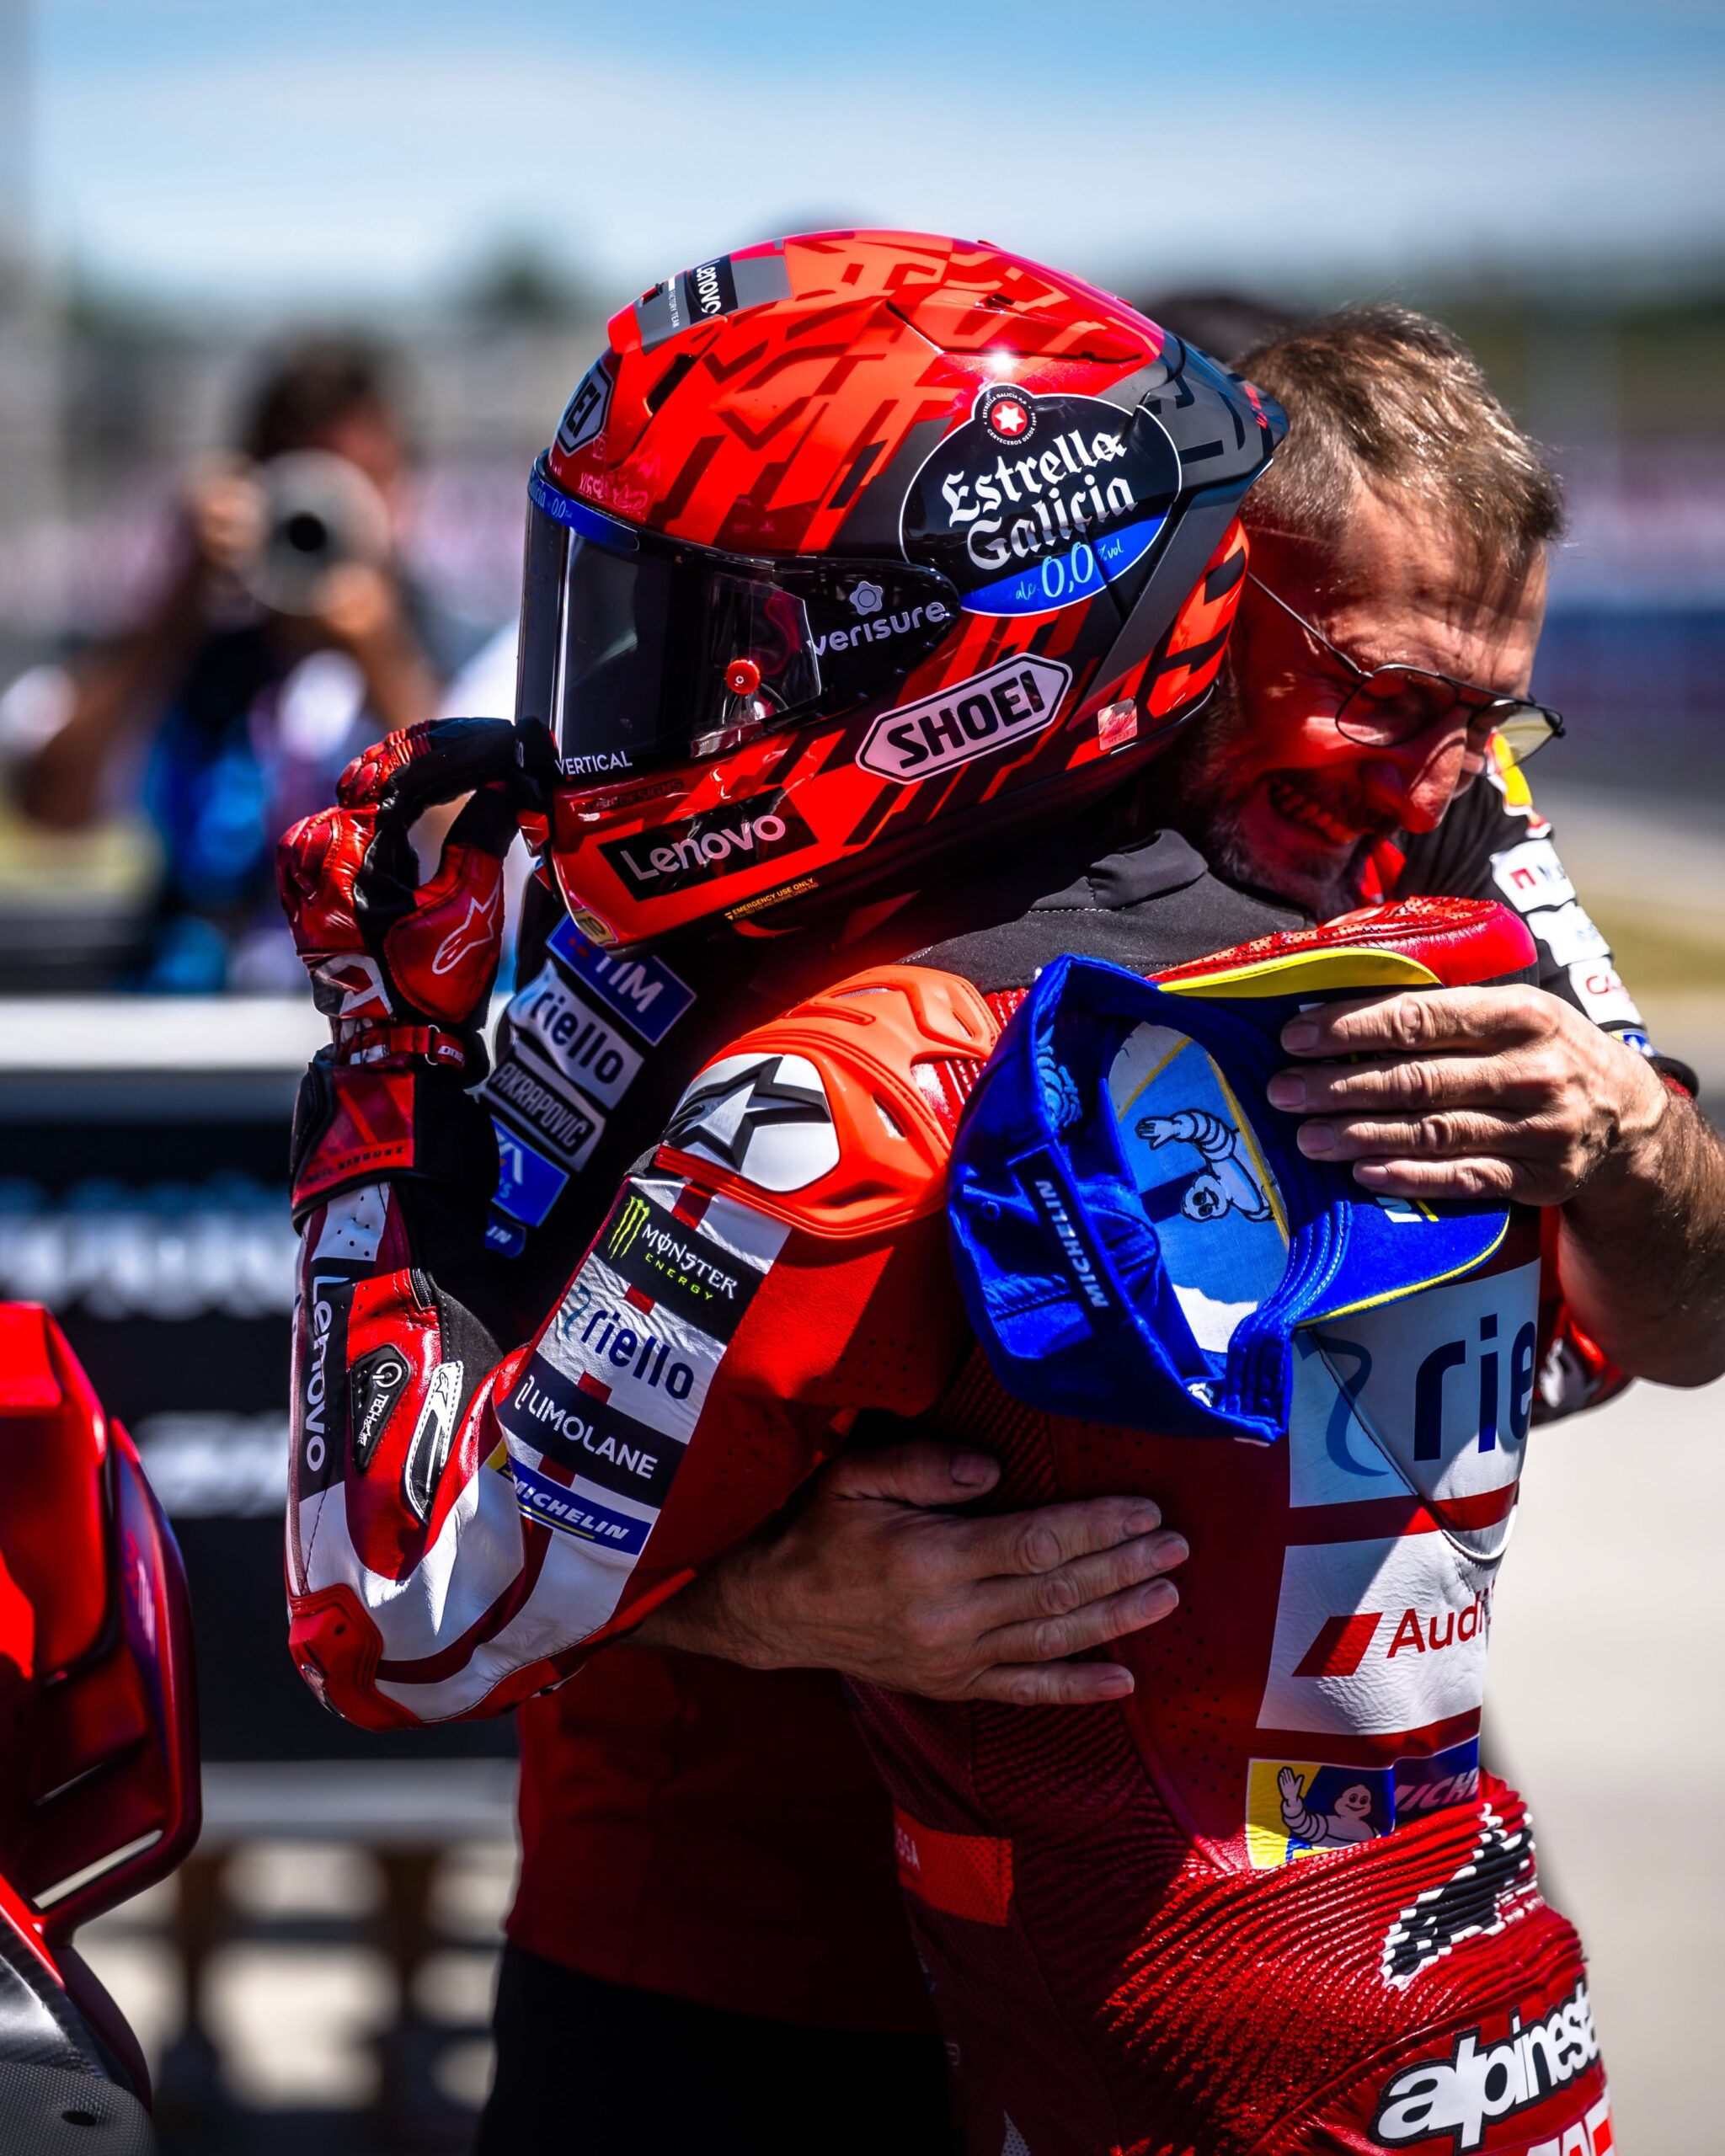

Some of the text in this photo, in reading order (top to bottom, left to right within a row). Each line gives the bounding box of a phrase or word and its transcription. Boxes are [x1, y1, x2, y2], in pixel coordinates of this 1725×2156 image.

[697, 259, 721, 314] Lenovo
[982, 397, 997, 419] ESTRELLA
[987, 428, 1022, 446] CERVECEROS
[1022, 427, 1035, 442] DESDE
[941, 429, 1128, 528] Estrella
[968, 473, 1138, 570] Galicia
[1041, 541, 1094, 598] 0,0
[806, 601, 947, 657] verisure
[886, 670, 1046, 770] SHOEI
[554, 750, 633, 776] VERTICAL
[620, 814, 787, 881] Lenovo
[732, 893, 776, 915] EMERGENCY
[777, 886, 793, 897] USE
[793, 878, 814, 890] ONLY
[530, 990, 624, 1084] riello
[642, 1223, 738, 1299] MONSTER
[644, 1252, 713, 1300] ENERGY
[1035, 1180, 1109, 1307] MICHELIN
[305, 1275, 351, 1472] Lenovo
[579, 1310, 695, 1400] riello
[1413, 1313, 1536, 1461] rie
[513, 1474, 630, 1540] MICHELIN
